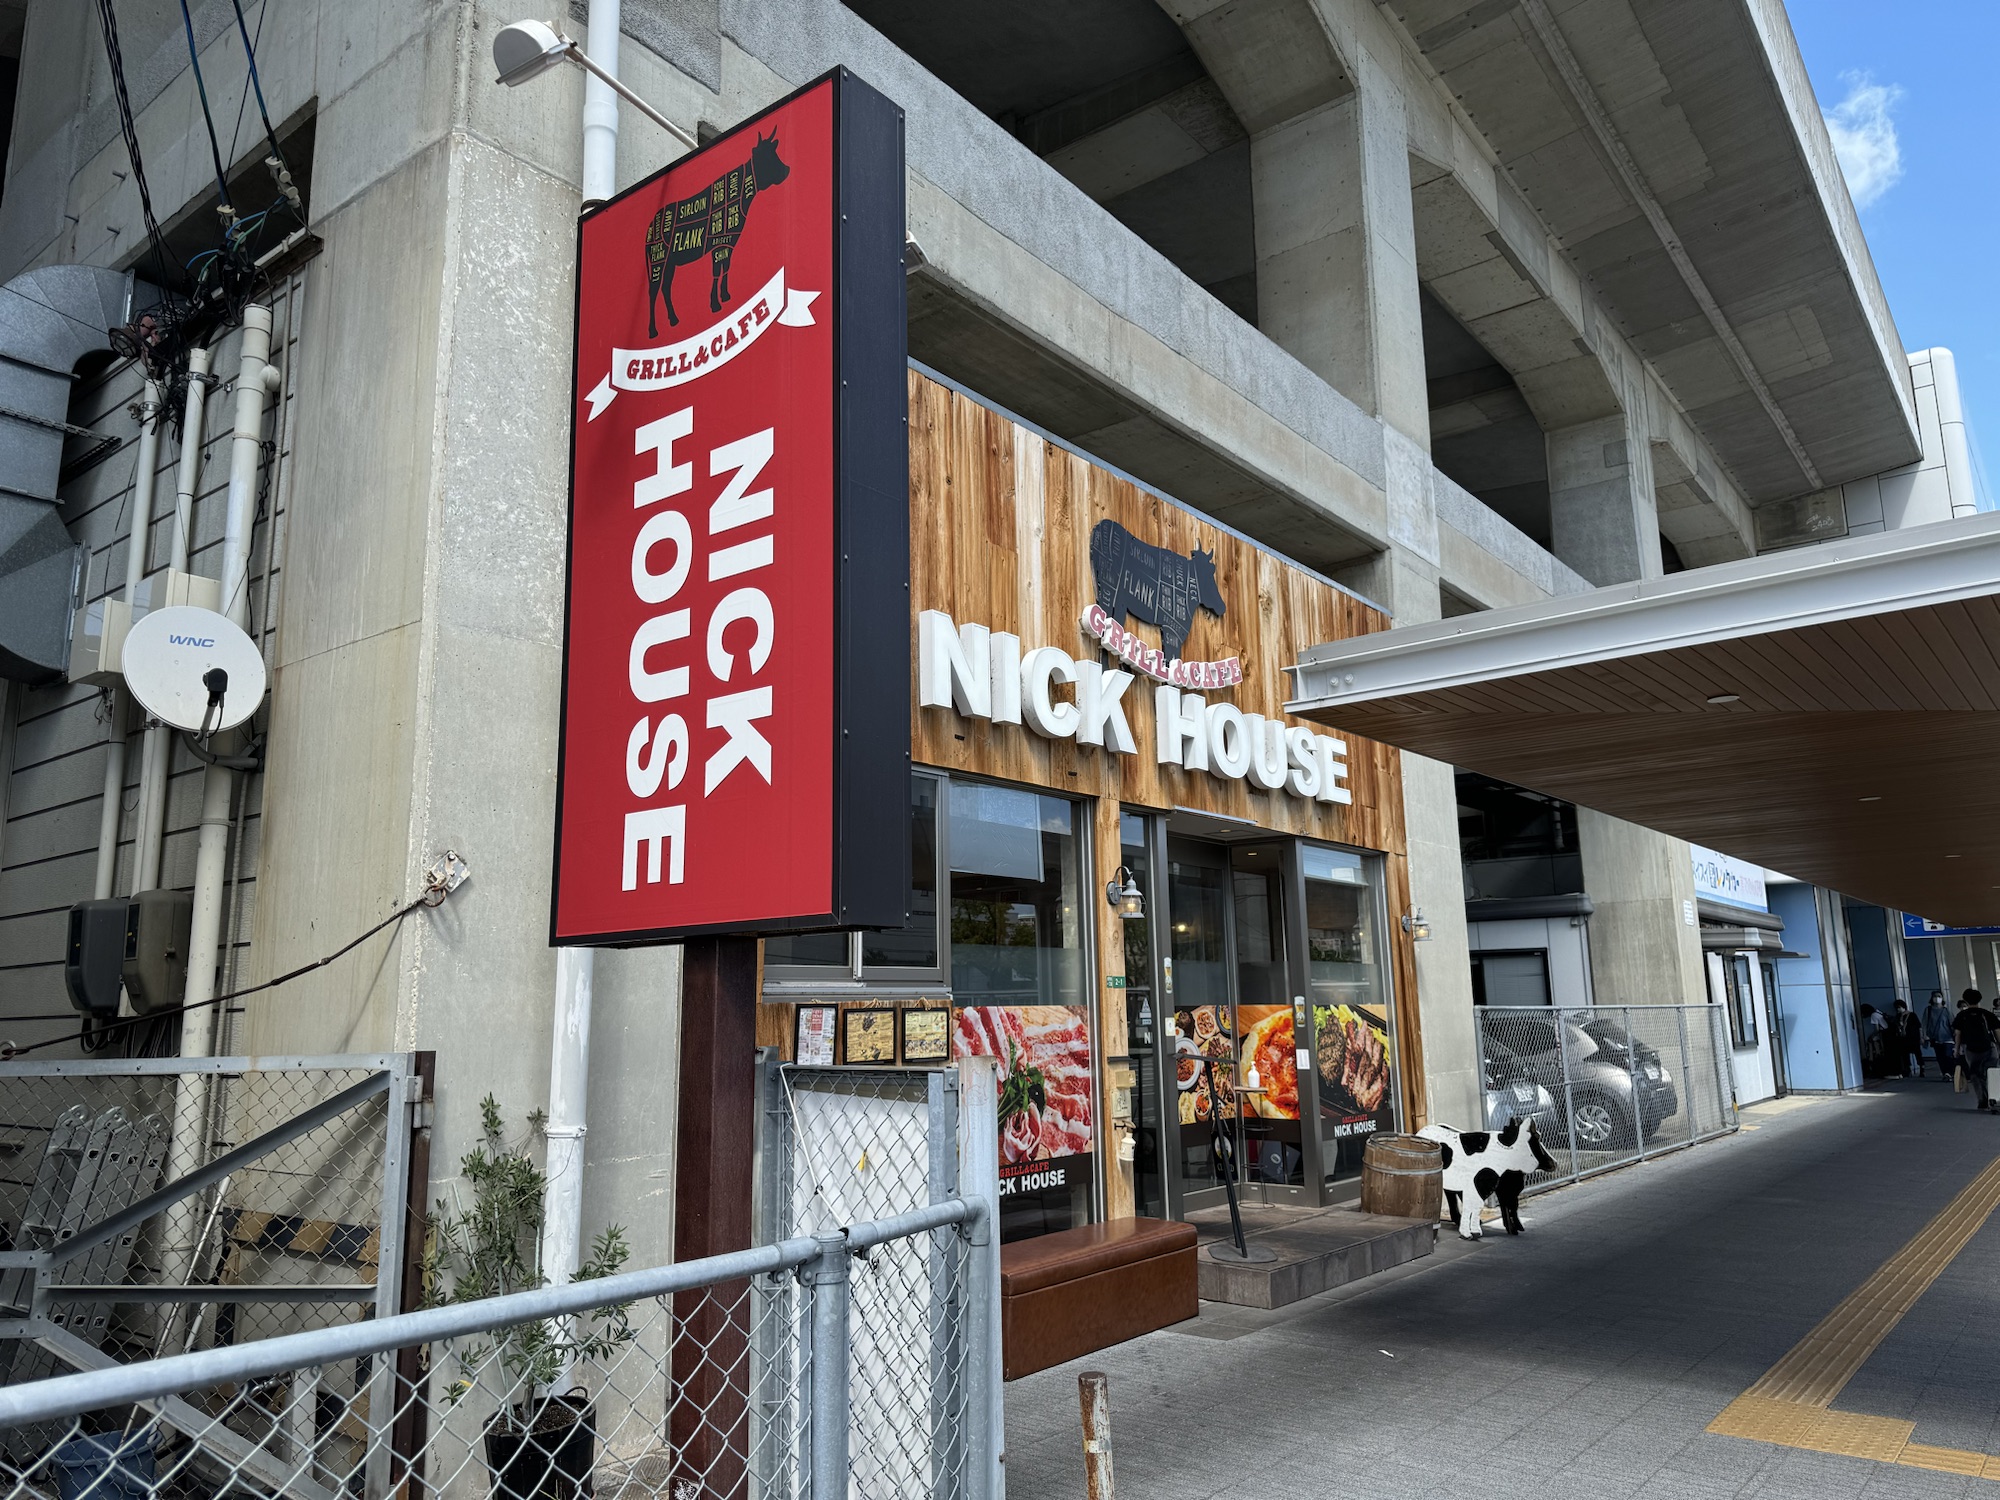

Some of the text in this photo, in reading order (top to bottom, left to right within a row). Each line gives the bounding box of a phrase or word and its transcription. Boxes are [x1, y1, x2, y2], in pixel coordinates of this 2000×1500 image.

[729, 171, 739, 199] CHUCK
[744, 174, 753, 199] NECK
[680, 196, 707, 219] SIRLOIN
[713, 190, 725, 205] RIB
[663, 209, 672, 233] RUMP
[728, 204, 739, 215] THICK
[728, 213, 740, 229] RIB
[711, 219, 723, 235] RIB
[650, 243, 664, 255] THICK
[673, 227, 705, 253] FLANK
[651, 251, 666, 263] FLANK
[714, 248, 729, 263] SHIN
[652, 266, 661, 282] LEG
[626, 297, 771, 381] GRILL&CAFE
[1129, 542, 1155, 570] SIRLOIN
[1175, 558, 1185, 587] CHUCK
[1103, 589, 1111, 607] LEG
[1123, 569, 1155, 611] FLANK
[1189, 577, 1198, 601] NECK
[705, 428, 775, 798] NICK
[169, 634, 215, 648] WNC
[621, 406, 695, 892] HOUSE
[919, 608, 1353, 807] NICK HOUSE
[1334, 1120, 1377, 1138] NICK HOUSE
[999, 1161, 1050, 1178] GRILL&CAFE
[1021, 1168, 1065, 1192] HOUSE
